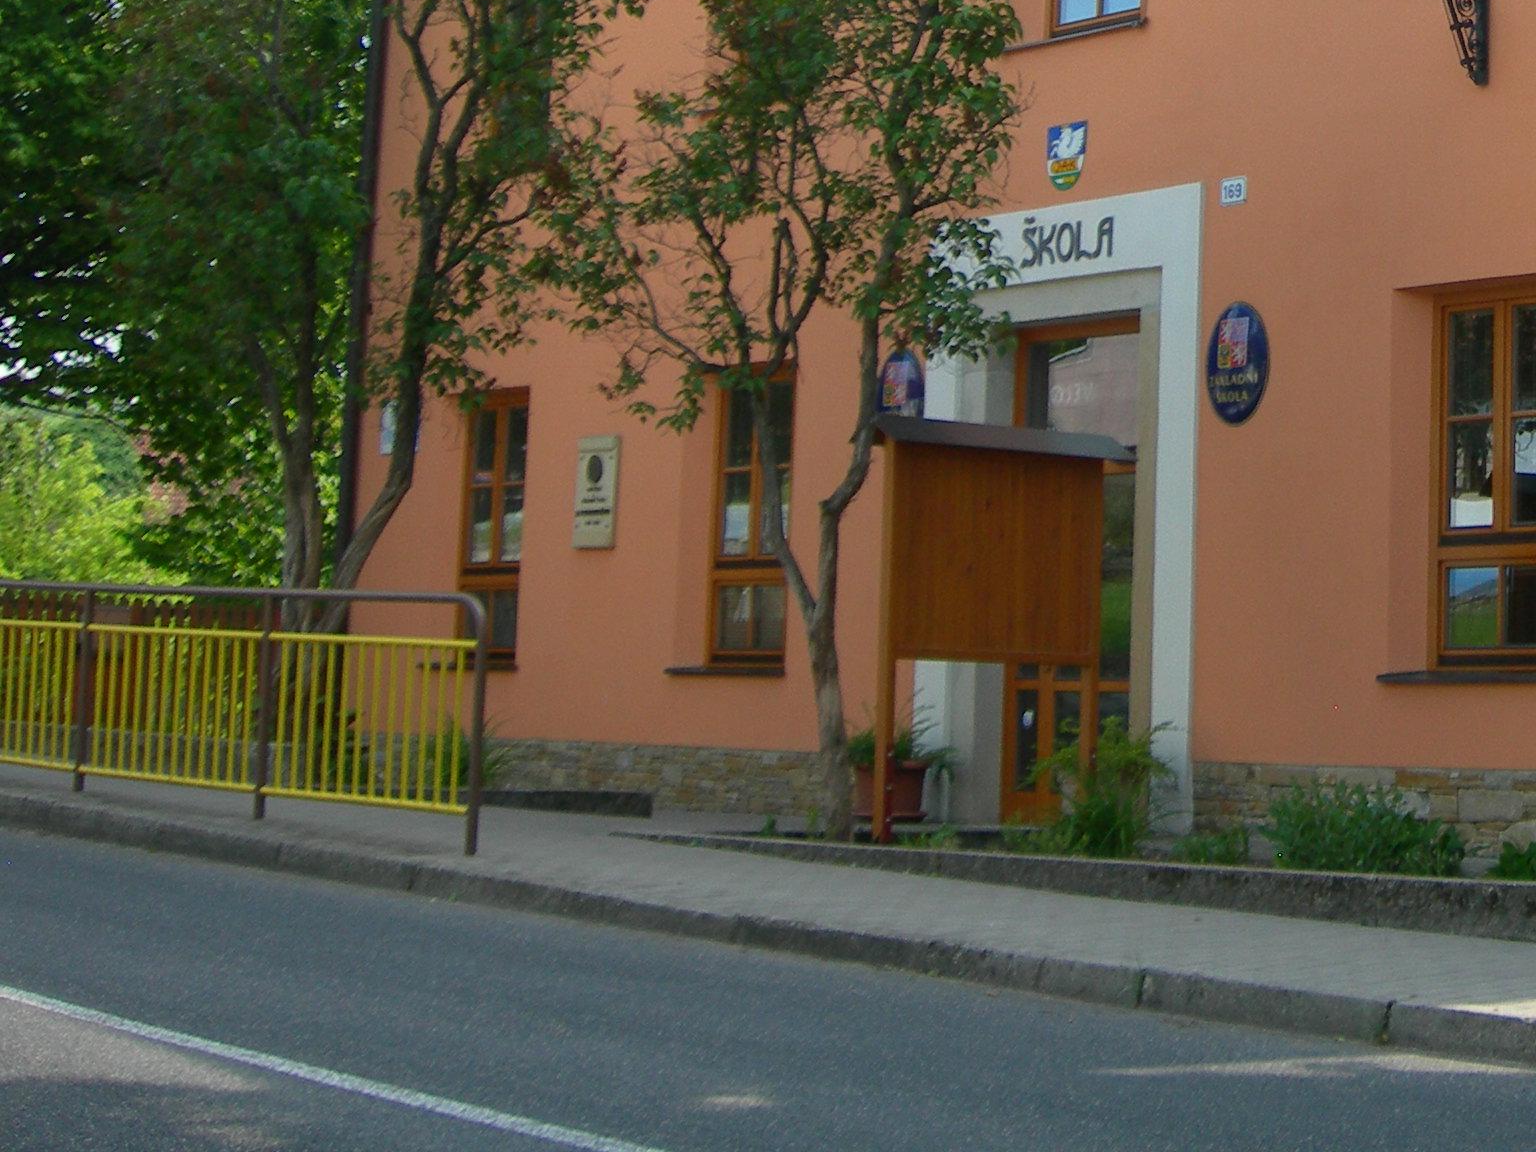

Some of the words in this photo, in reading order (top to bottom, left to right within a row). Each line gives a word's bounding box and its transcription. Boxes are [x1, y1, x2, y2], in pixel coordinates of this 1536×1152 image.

[1223, 183, 1242, 199] 169
[1019, 215, 1114, 269] ŠKOLA
[1216, 386, 1249, 403] ŠKOLA
